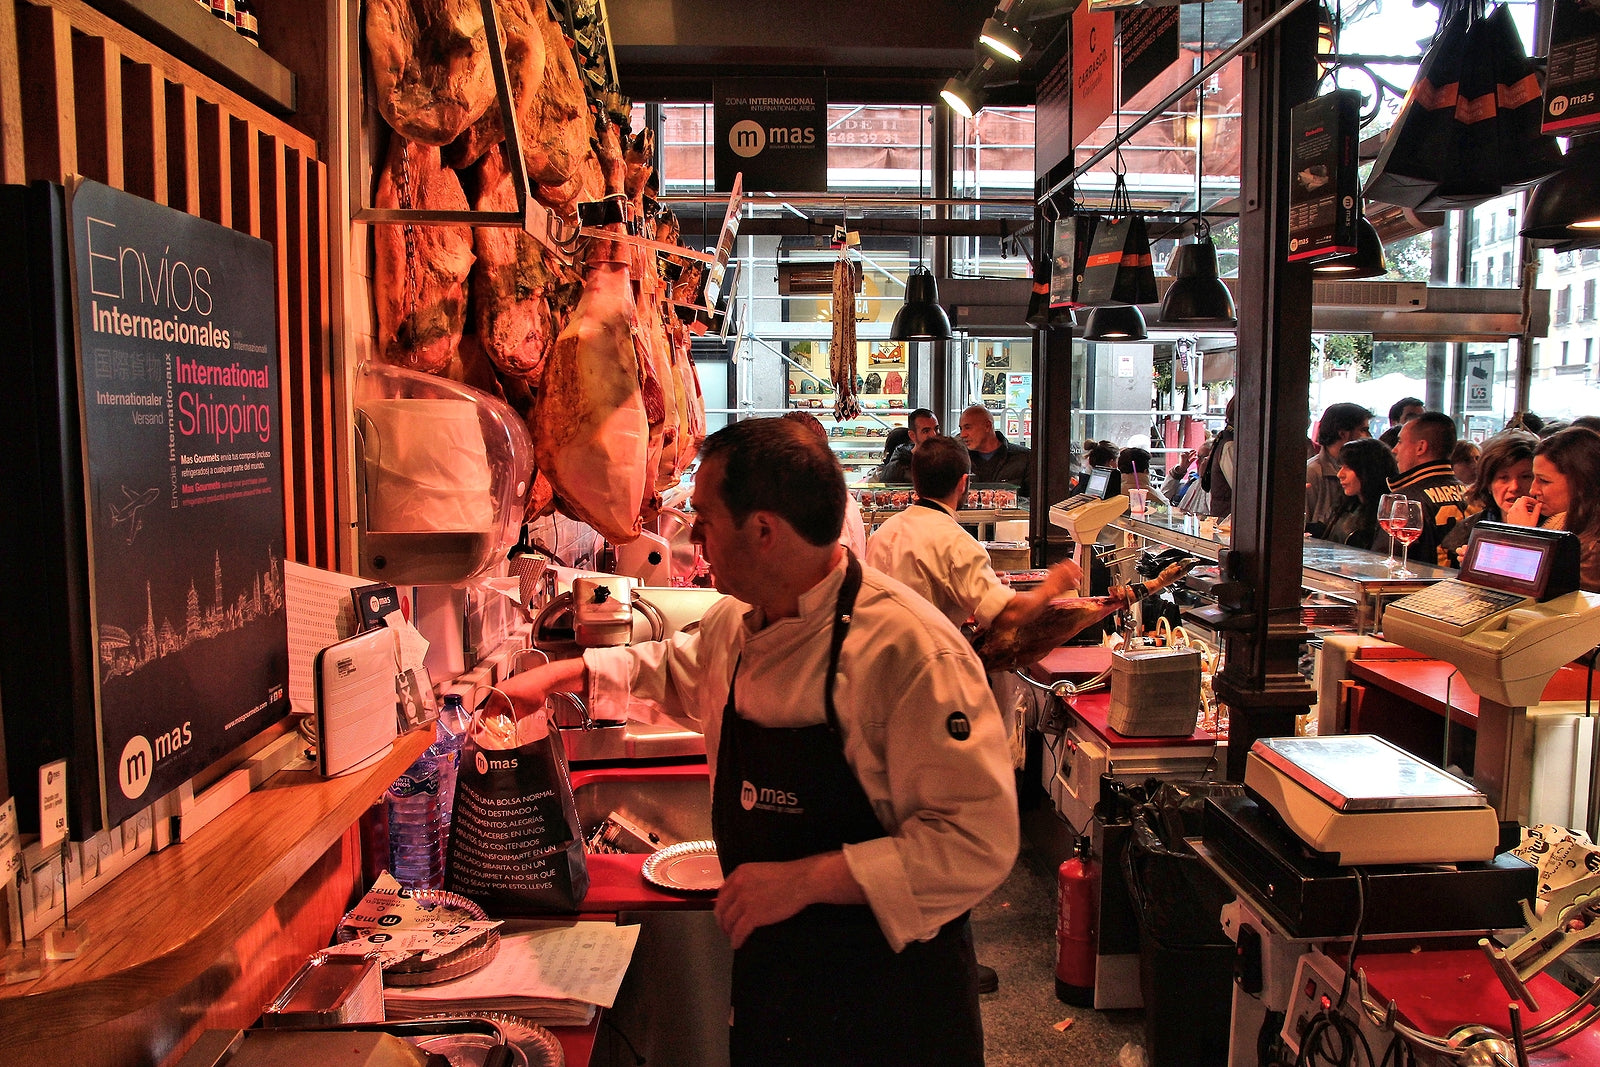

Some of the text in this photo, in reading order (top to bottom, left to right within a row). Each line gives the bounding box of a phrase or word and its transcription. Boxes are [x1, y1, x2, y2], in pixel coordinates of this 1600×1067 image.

[725, 97, 815, 106] ZONA INTERNACIONAL
[1569, 92, 1595, 106] mas
[769, 127, 815, 144] mas
[828, 132, 855, 143] 548
[860, 133, 877, 143] 39
[87, 216, 213, 316] Envíos
[92, 301, 230, 349] Internacionales
[176, 355, 269, 389] International
[97, 390, 163, 406] Internationaler
[165, 353, 176, 462] Internationaux
[132, 411, 164, 425] Versand
[178, 391, 271, 444] Shipping
[181, 454, 193, 465] Mas
[194, 453, 220, 463] Gourmets
[154, 721, 192, 762] mas
[490, 757, 518, 770] mas
[496, 797, 521, 807] BOLSA
[522, 789, 555, 803] NORMAL
[760, 788, 798, 806] mas
[488, 806, 531, 818] DESTINADO
[523, 826, 545, 836] UNOS
[489, 839, 540, 851] CONTENIDOS
[533, 848, 543, 856] EN
[544, 845, 556, 854] UN
[521, 863, 532, 871] EN
[534, 860, 546, 869] UN
[470, 869, 502, 880] GOURMET
[511, 873, 524, 881] NO
[525, 873, 539, 881] SER
[540, 869, 556, 879] QUE
